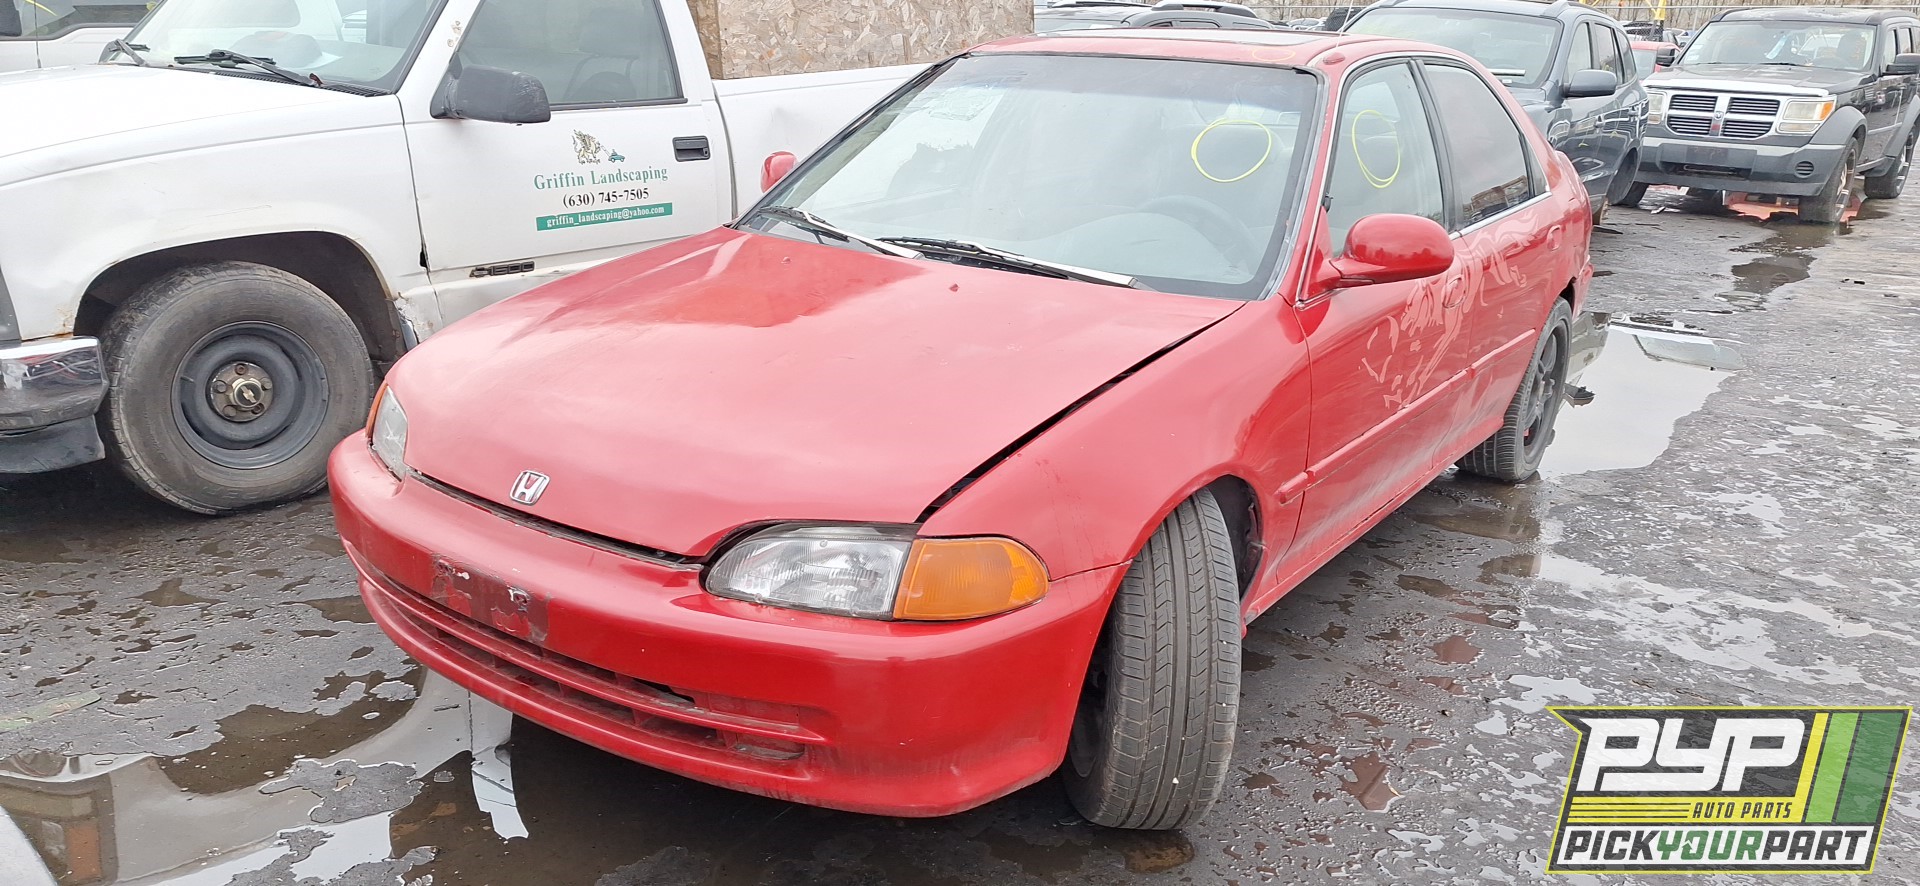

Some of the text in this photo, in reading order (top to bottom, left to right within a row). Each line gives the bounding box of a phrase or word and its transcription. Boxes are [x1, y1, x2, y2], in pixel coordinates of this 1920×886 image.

[534, 166, 669, 190] Griffin Landscaping
[563, 187, 650, 209] (630) 745-7505
[546, 206, 665, 228] griffin_landscaping@yahoo.com
